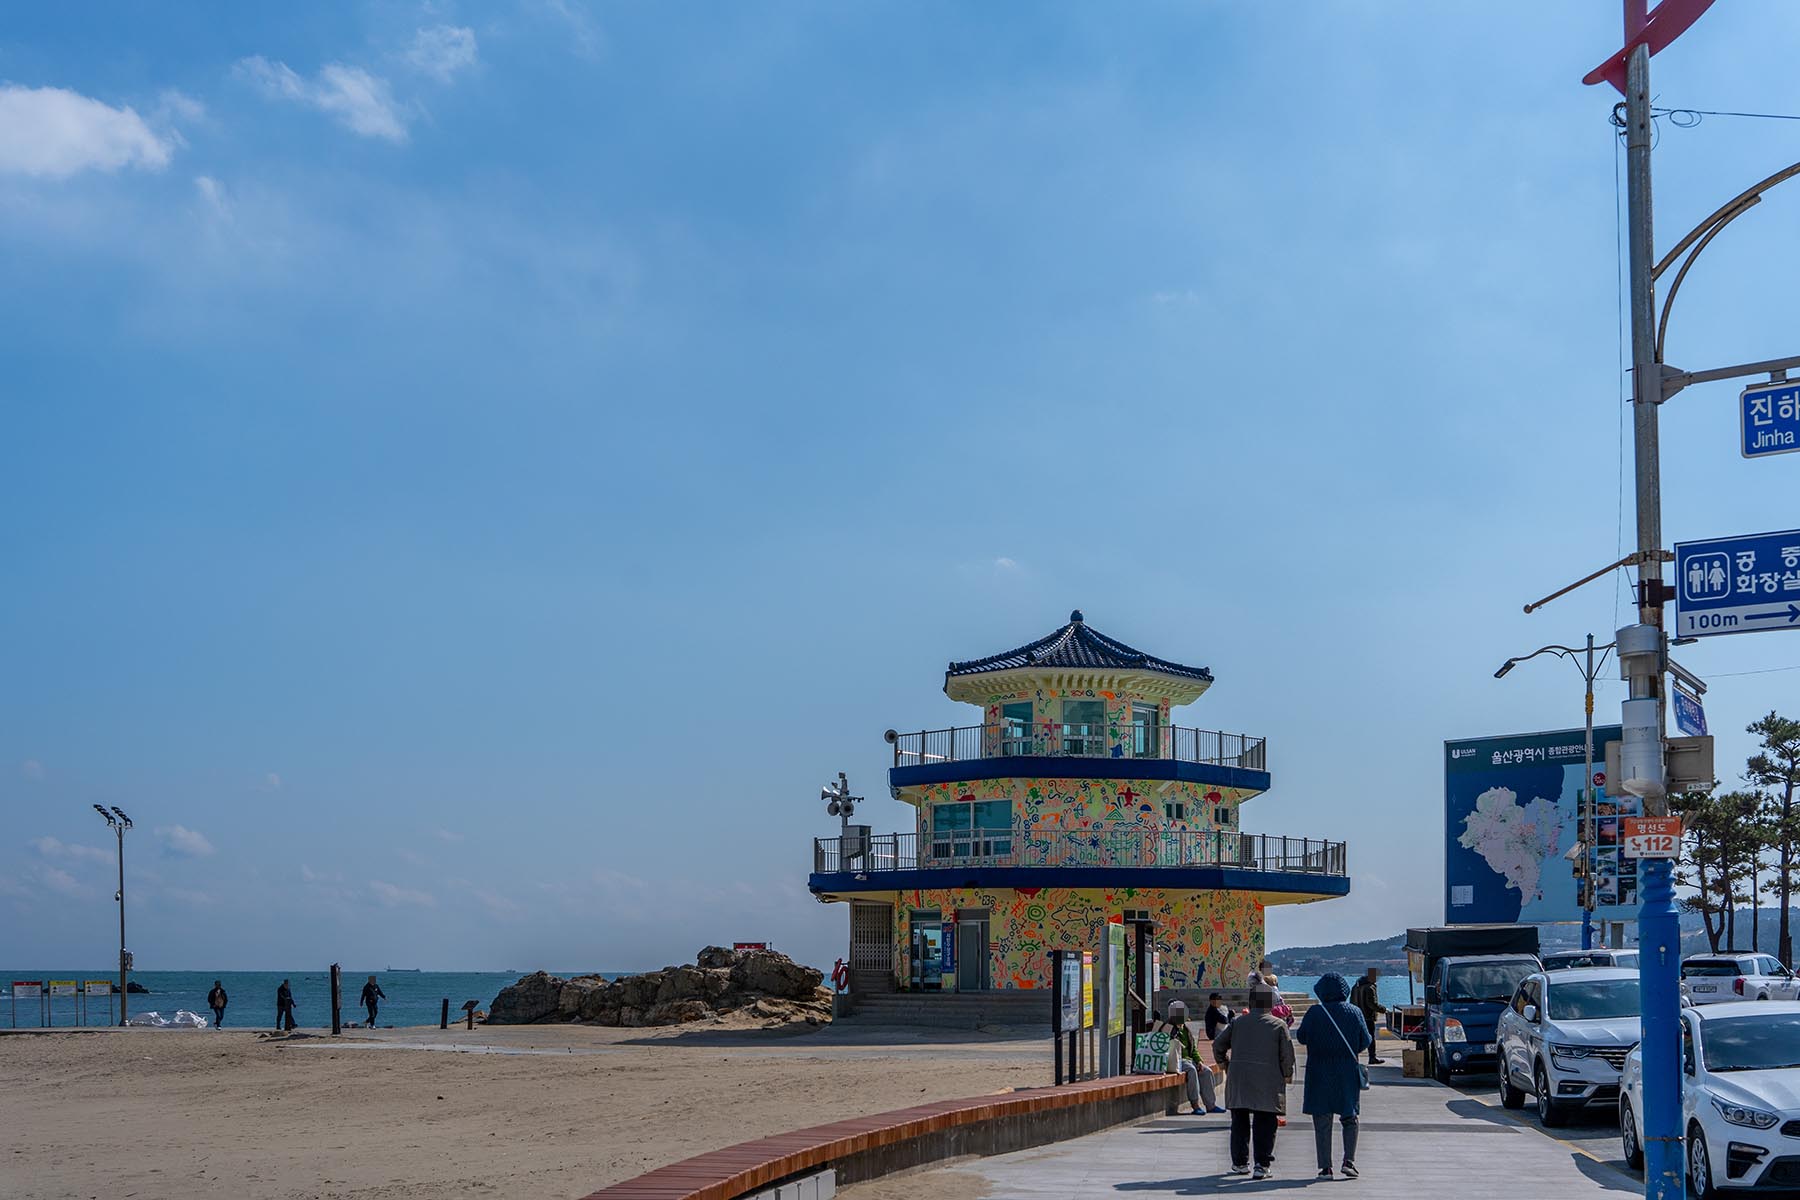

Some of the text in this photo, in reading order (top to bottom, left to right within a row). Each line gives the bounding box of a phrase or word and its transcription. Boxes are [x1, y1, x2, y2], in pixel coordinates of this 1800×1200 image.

[1749, 391, 1800, 426] 진하
[1752, 428, 1795, 449] Jinha
[1736, 570, 1800, 594] 화장실
[1688, 612, 1739, 630] 100m
[1491, 747, 1545, 765] 울산광역시
[1637, 823, 1667, 834] 명선도
[1644, 836, 1673, 851] 112
